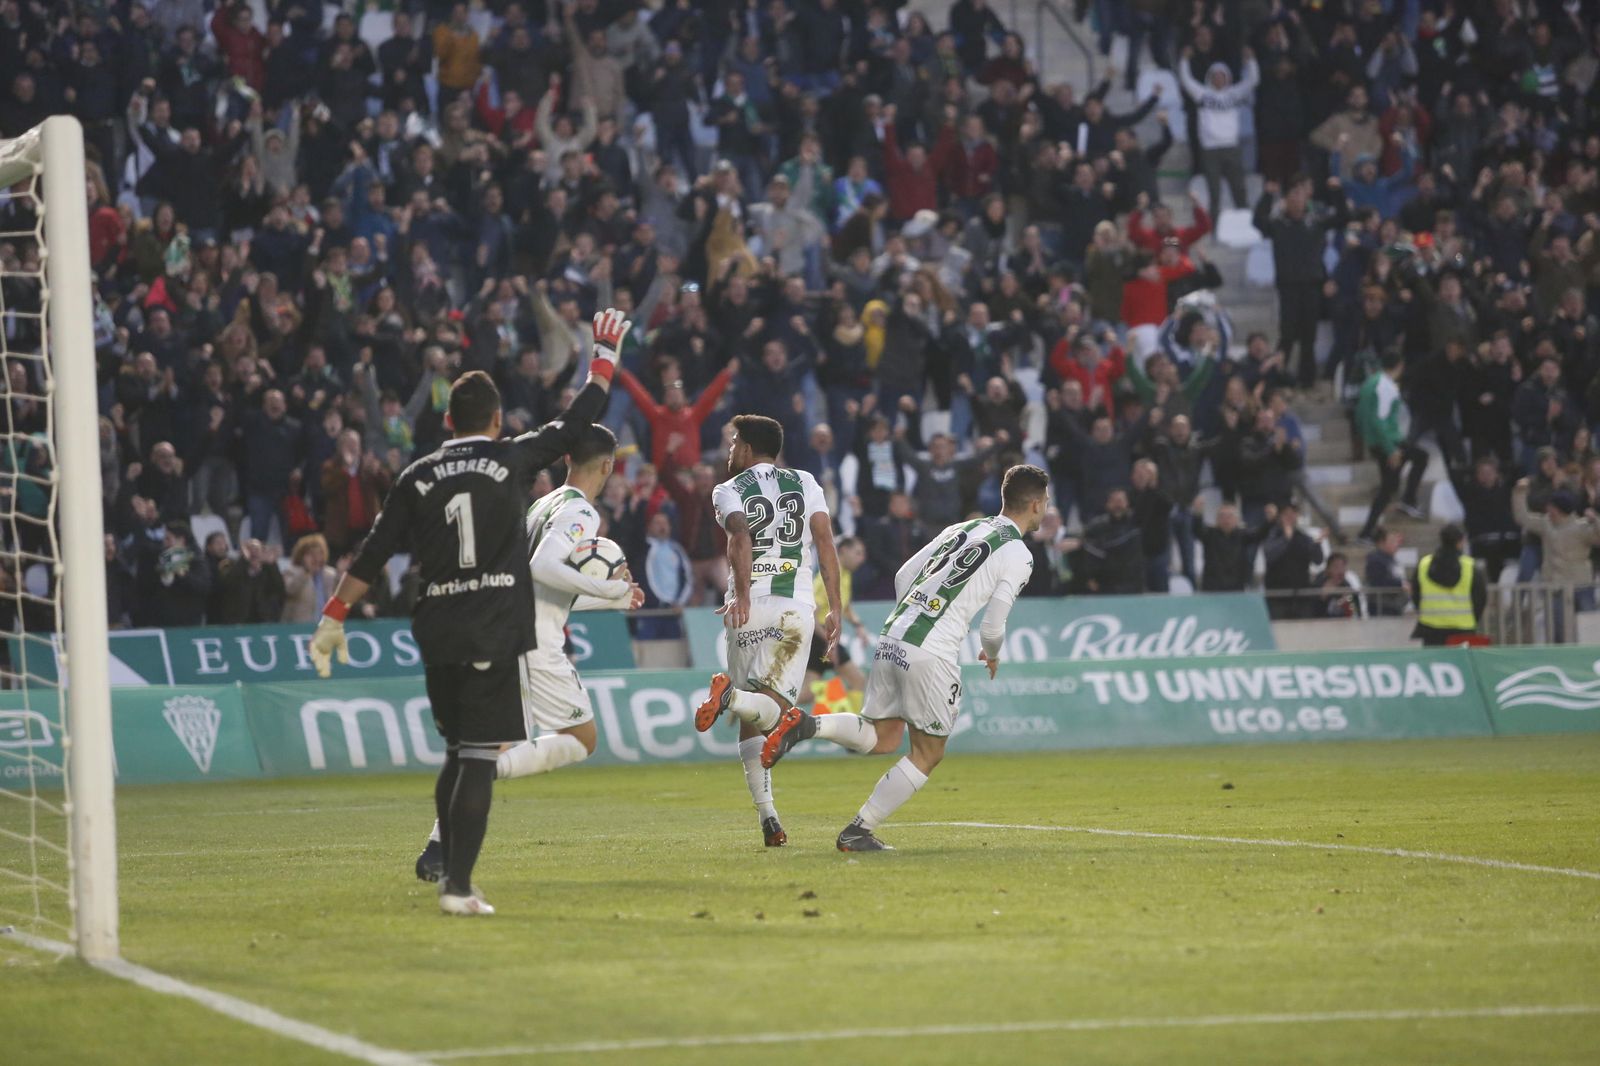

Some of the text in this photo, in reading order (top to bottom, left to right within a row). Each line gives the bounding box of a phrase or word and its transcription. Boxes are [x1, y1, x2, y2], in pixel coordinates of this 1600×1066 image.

[433, 458, 509, 482] HERRERO
[444, 492, 476, 569] 1
[744, 491, 806, 551] 23
[480, 573, 515, 588] Auto
[752, 563, 778, 574] EDRA
[922, 530, 992, 589] 39
[1060, 614, 1249, 661] Radler
[1083, 662, 1465, 704] TU UNIVERSIDAD
[1208, 705, 1348, 734] uco.es
